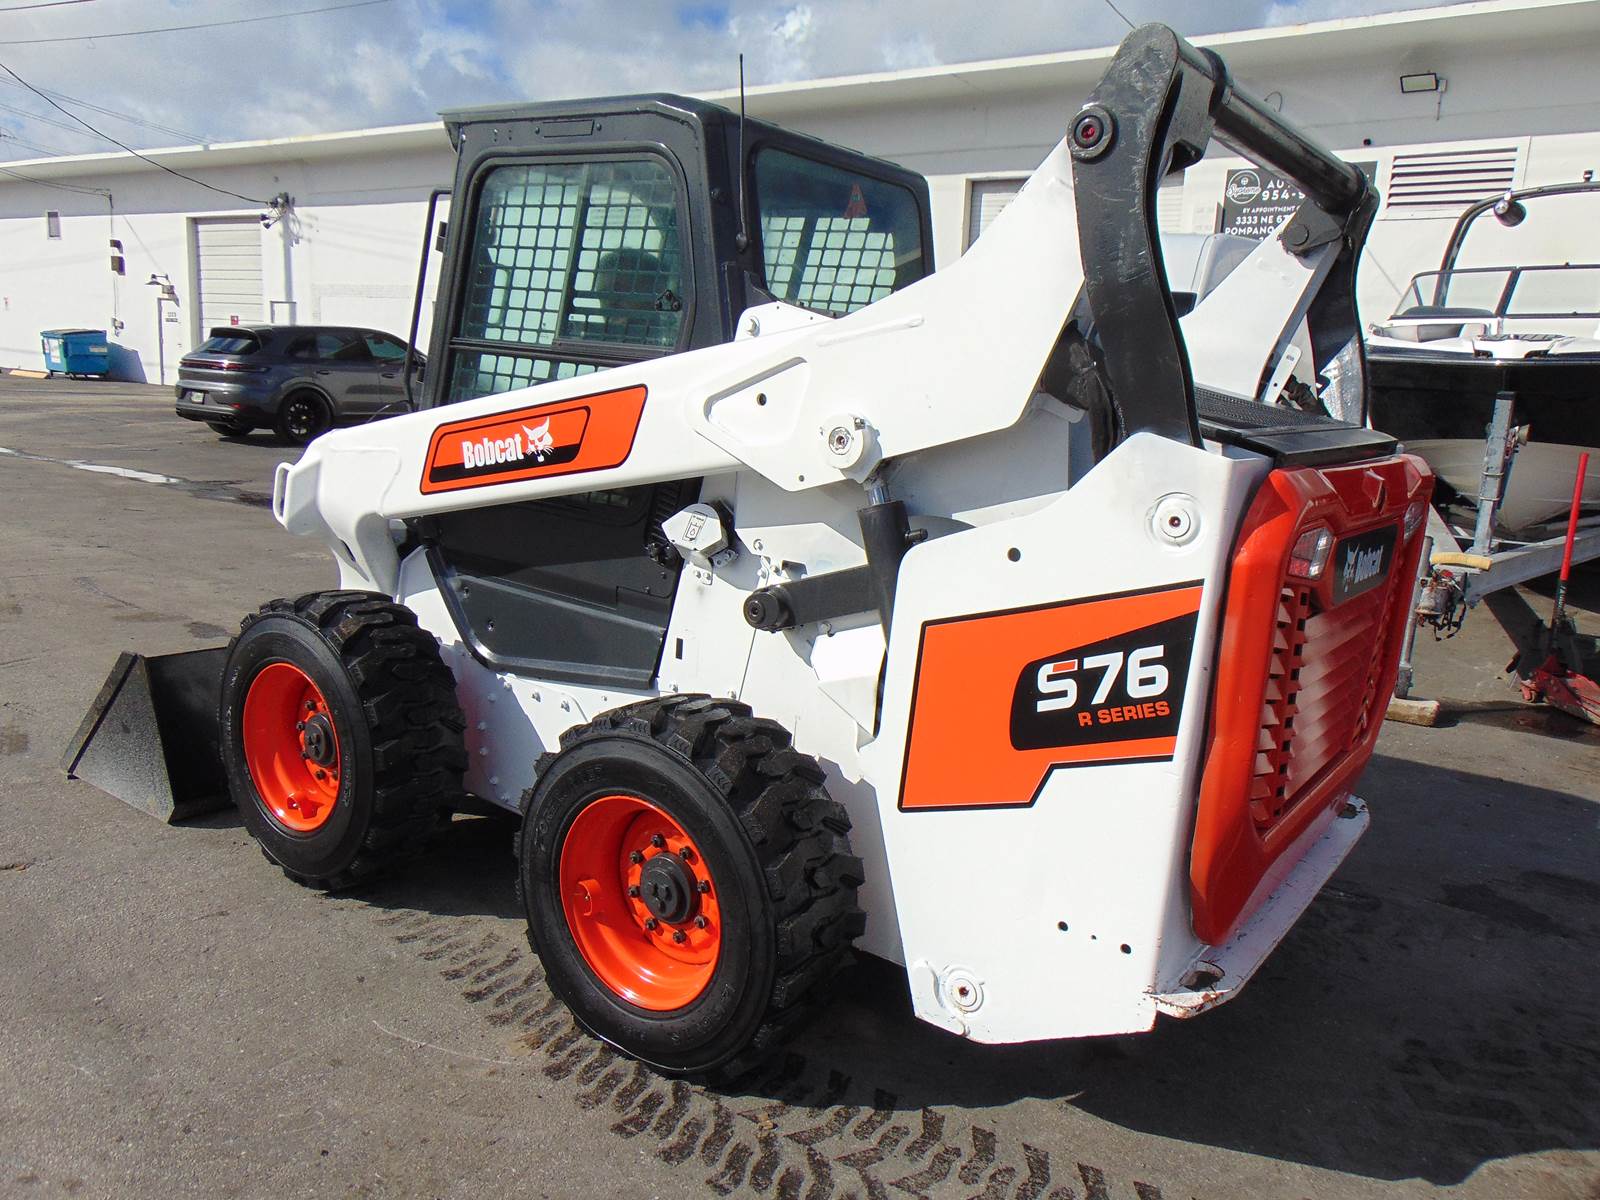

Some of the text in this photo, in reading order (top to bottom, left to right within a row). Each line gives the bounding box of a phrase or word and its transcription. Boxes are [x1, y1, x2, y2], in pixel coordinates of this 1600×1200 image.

[1235, 215, 1258, 225] 3333
[1260, 215, 1274, 224] NE
[1251, 205, 1296, 213] APPOINTMENT
[1225, 226, 1275, 236] POMPANO
[462, 433, 524, 469] Bobcat
[1354, 544, 1384, 584] Bobcat
[1036, 644, 1169, 713] S76
[1077, 700, 1171, 727] R SERIES
